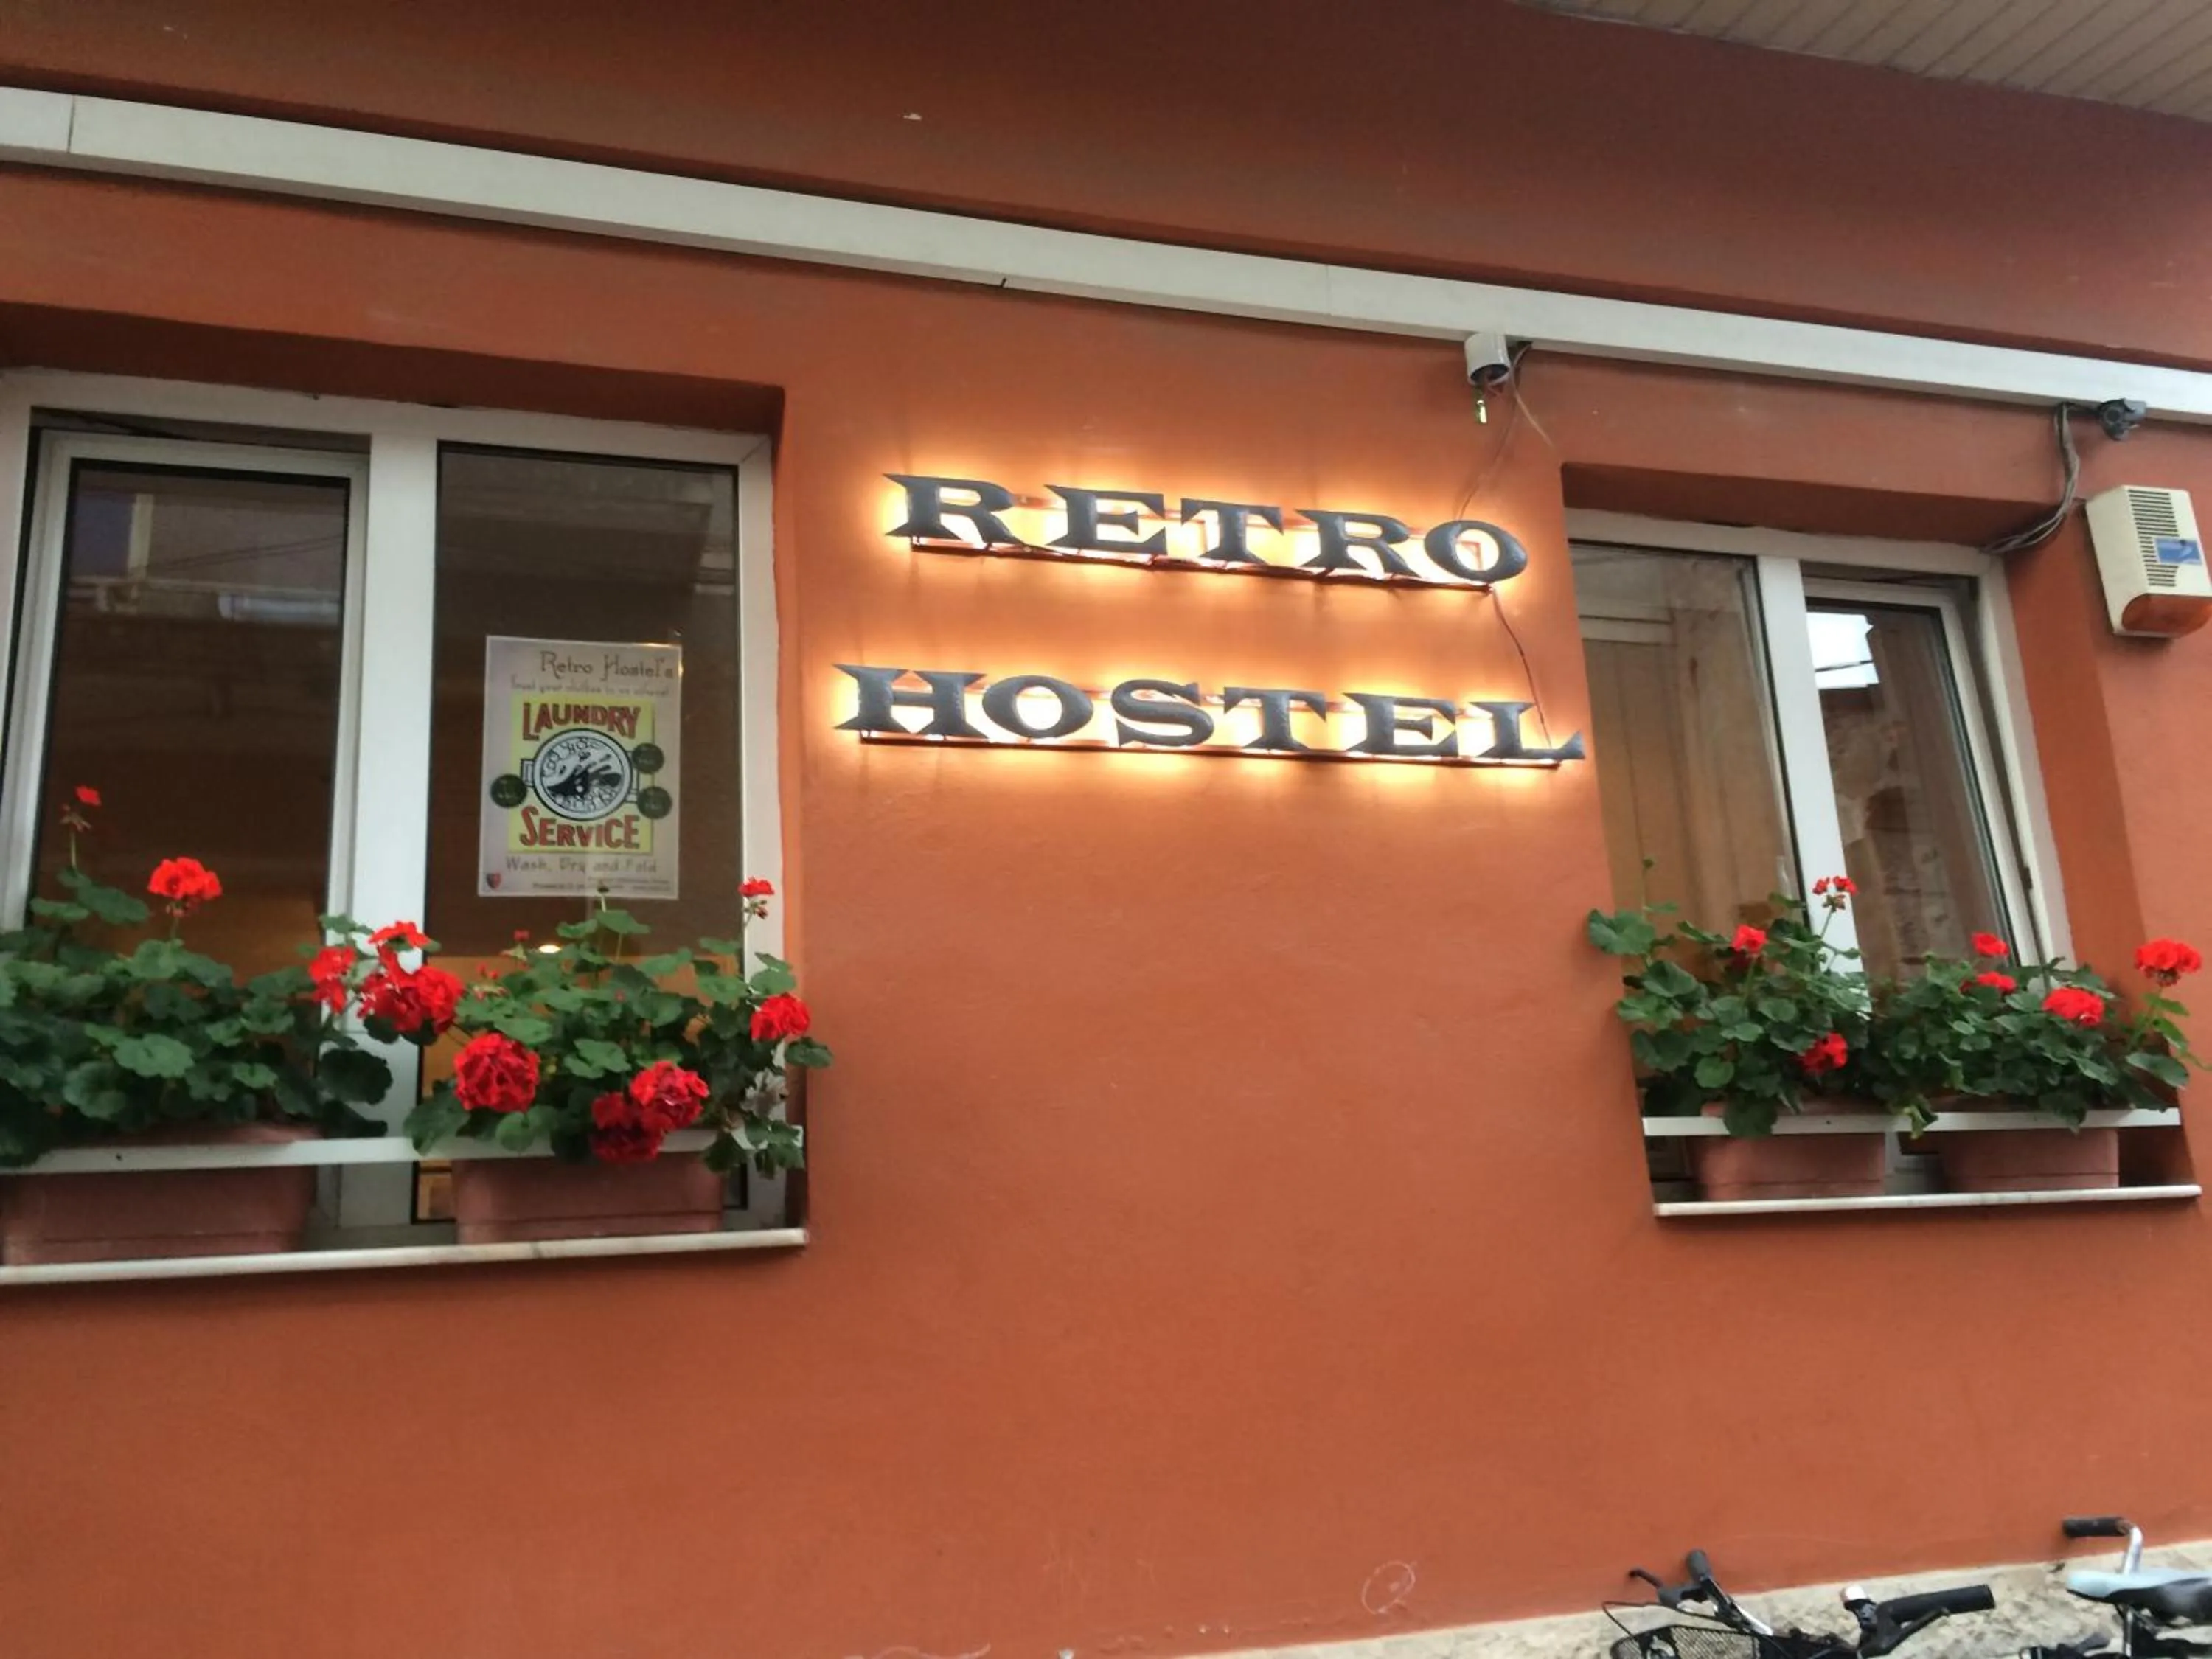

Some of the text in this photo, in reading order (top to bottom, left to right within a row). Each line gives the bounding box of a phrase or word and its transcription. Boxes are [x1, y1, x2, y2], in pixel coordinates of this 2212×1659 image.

[884, 474, 1528, 583] RETRO
[540, 650, 593, 680] Retro
[521, 702, 641, 741] LAUNDRY
[834, 664, 1585, 760] HOSTEL
[519, 805, 640, 849] SERVICE
